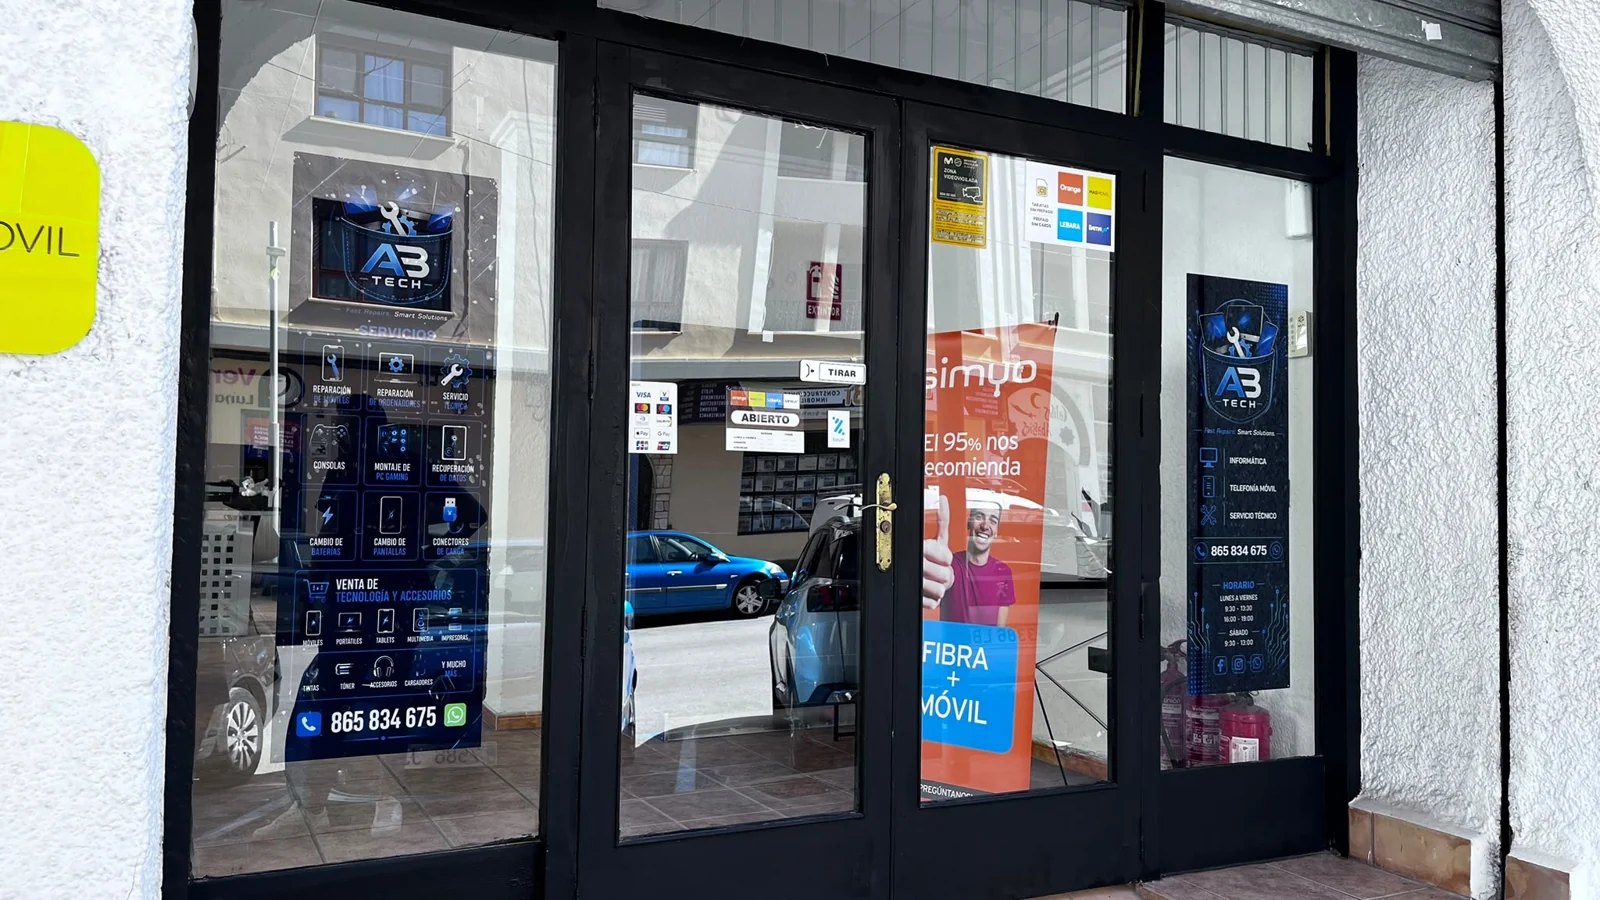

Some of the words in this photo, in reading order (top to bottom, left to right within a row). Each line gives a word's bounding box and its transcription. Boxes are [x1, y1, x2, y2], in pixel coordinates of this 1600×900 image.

[944, 174, 978, 183] VIDEOVIGILADA
[1060, 184, 1081, 194] Orange
[1060, 221, 1080, 230] LEBARA
[360, 243, 430, 278] AB
[372, 276, 421, 289] TECH
[394, 311, 415, 319] Smart
[808, 305, 840, 316] EXTINTOR
[359, 325, 436, 340] SERVICIOS
[828, 369, 856, 377] TIRAR
[926, 357, 1037, 397] simyo
[1215, 366, 1262, 399] AB
[313, 385, 351, 395] REPARACIÓN
[377, 388, 414, 398] REPARACIÓN
[323, 396, 350, 404] MÓVILES
[443, 392, 469, 401] SERVICIO
[379, 399, 420, 408] ORDENADORES
[1222, 399, 1256, 408] TECH
[742, 413, 790, 424] ABIERTO
[924, 433, 938, 452] El
[944, 432, 981, 452] 95%
[987, 435, 1018, 450] nos
[1230, 456, 1267, 465] INFORMÁTICA
[314, 461, 346, 470] CONSOLAS
[375, 463, 401, 472] MONTAJE
[403, 464, 410, 472] DE
[432, 464, 474, 473] RECUPERACIÓN
[924, 457, 1020, 476] ecomienda
[386, 473, 408, 481] GAMING
[449, 474, 466, 482] DATOS
[1230, 484, 1259, 492] TELEFONÍA
[1260, 484, 1276, 493] MÓVIL
[1230, 512, 1254, 520] SERVICIO
[1255, 511, 1277, 520] TÉCNICO
[309, 538, 332, 546] CAMBIO
[334, 538, 343, 546] DE
[374, 538, 396, 546] CAMBIO
[398, 538, 406, 546] DE
[433, 538, 469, 546] CONECTORES
[311, 547, 341, 556] BATERÍAS
[373, 548, 406, 556] PANTALLAS
[437, 547, 445, 555] DE
[446, 547, 464, 555] CARGA
[1211, 546, 1229, 556] 865
[1230, 546, 1248, 556] 834
[1250, 545, 1267, 556] 675
[336, 579, 365, 590] VENTA
[367, 579, 378, 590] DE
[1223, 581, 1255, 590] HORARIO
[336, 589, 389, 602] TECNOLOGÍA
[392, 591, 398, 601] Y
[400, 590, 452, 601] ACCESORIOS
[1229, 628, 1248, 636] SÁBADO
[302, 638, 323, 646] MÓVILES
[336, 637, 362, 645] PORTÁTILES
[922, 641, 988, 670] FIBRA
[446, 660, 466, 668] MUCHO
[947, 671, 960, 687] +
[303, 684, 319, 692] TINTAS
[340, 682, 355, 690] TÓNER
[370, 680, 397, 688] ACCESORIOS
[922, 690, 987, 725] MÓVIL
[331, 710, 364, 733] 865
[369, 708, 401, 730] 834
[406, 706, 437, 727] 675
